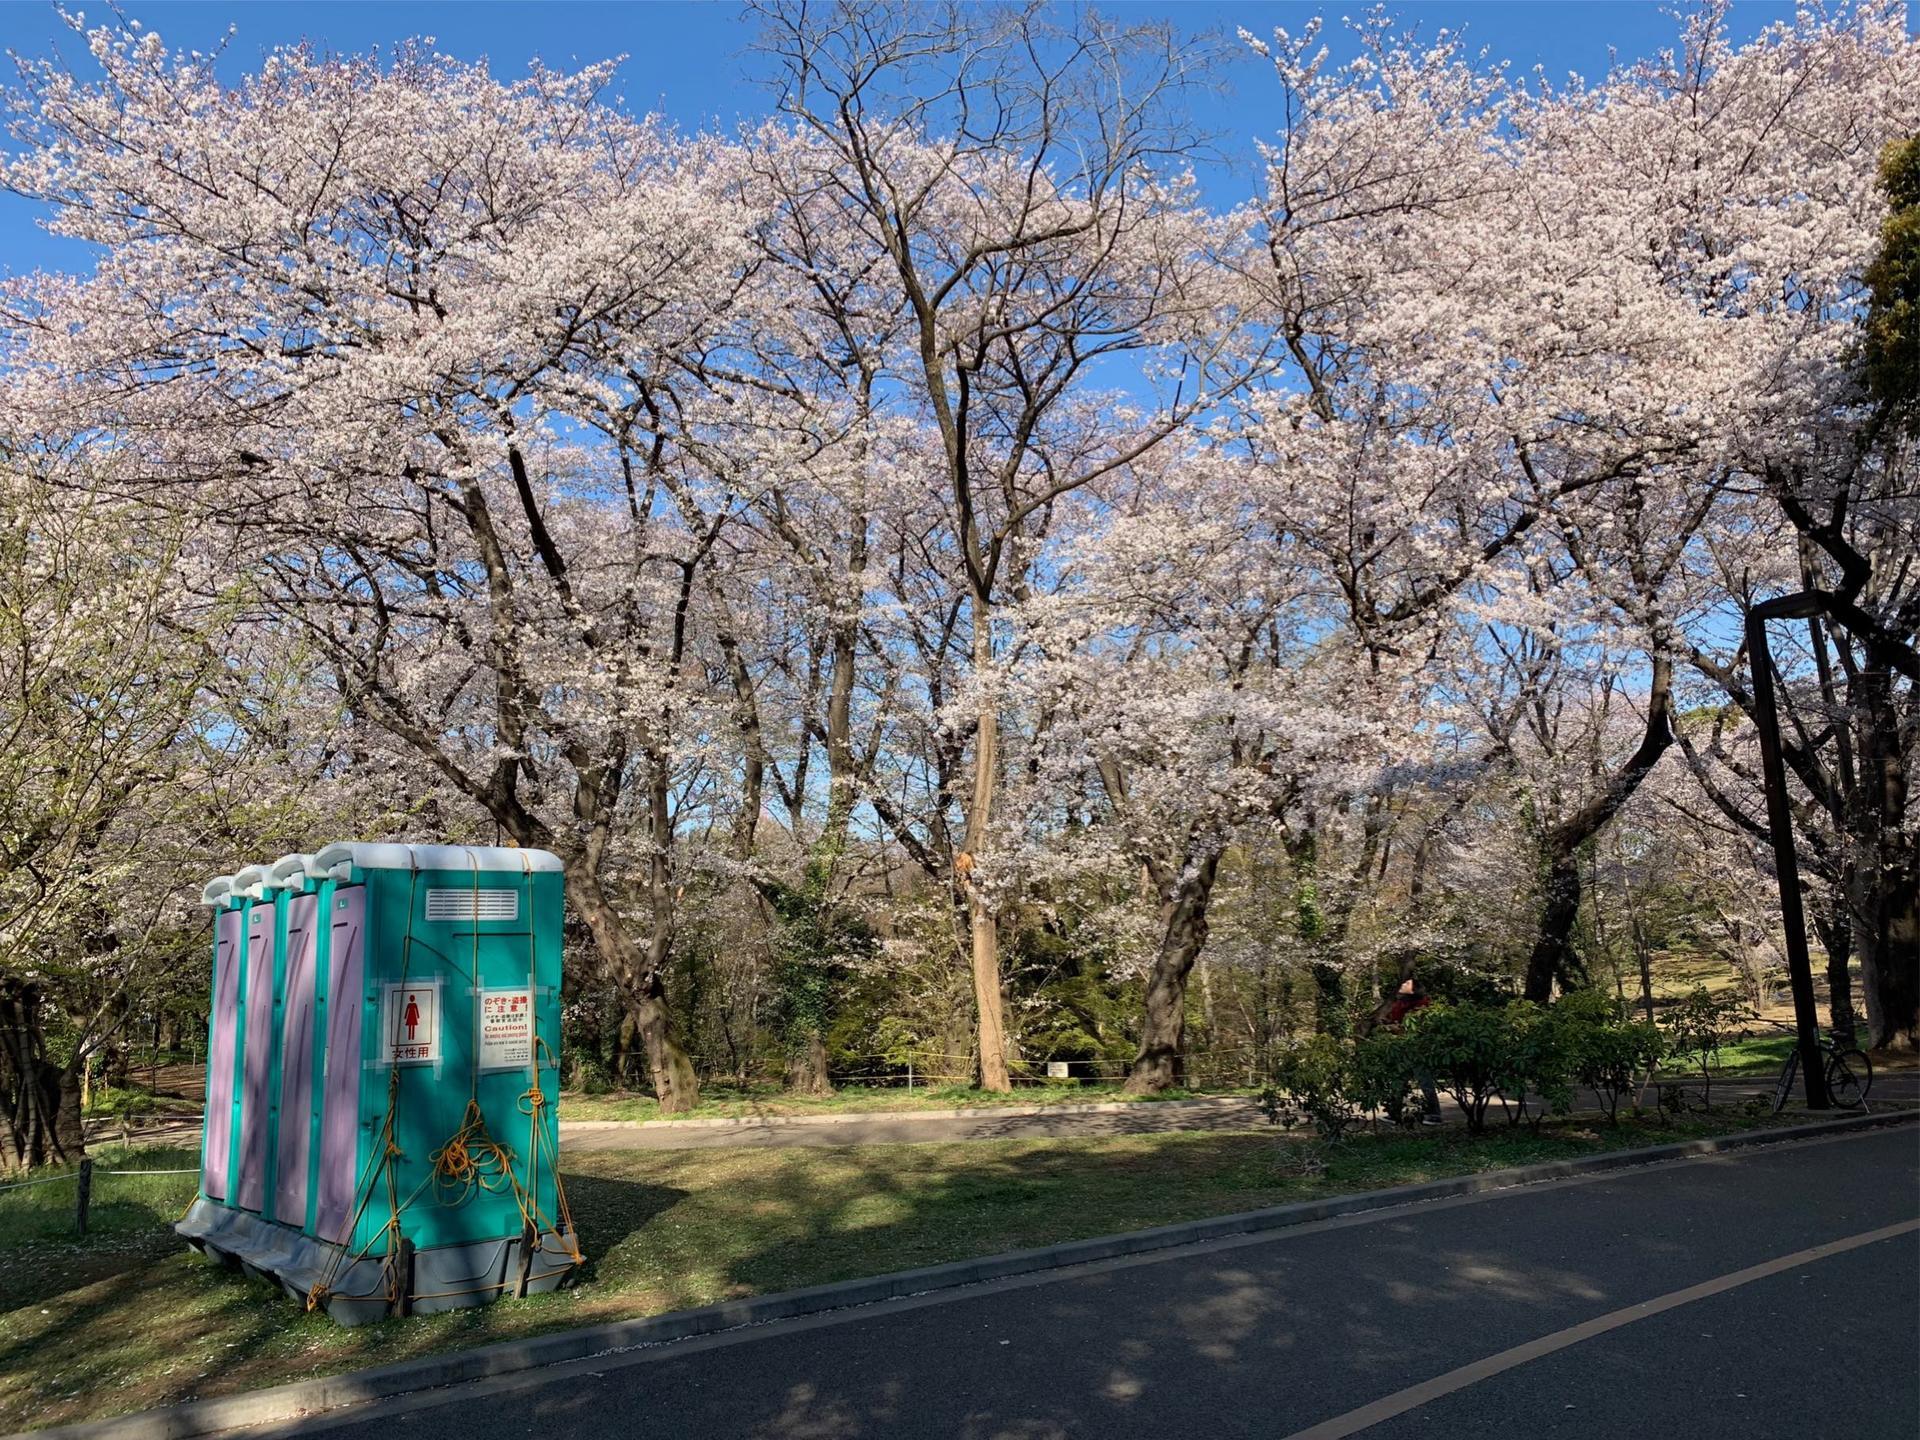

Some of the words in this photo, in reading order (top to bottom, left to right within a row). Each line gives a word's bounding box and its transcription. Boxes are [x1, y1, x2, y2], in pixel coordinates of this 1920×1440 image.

[484, 1023, 527, 1031] Caution!
[391, 1047, 428, 1059] 女性用
